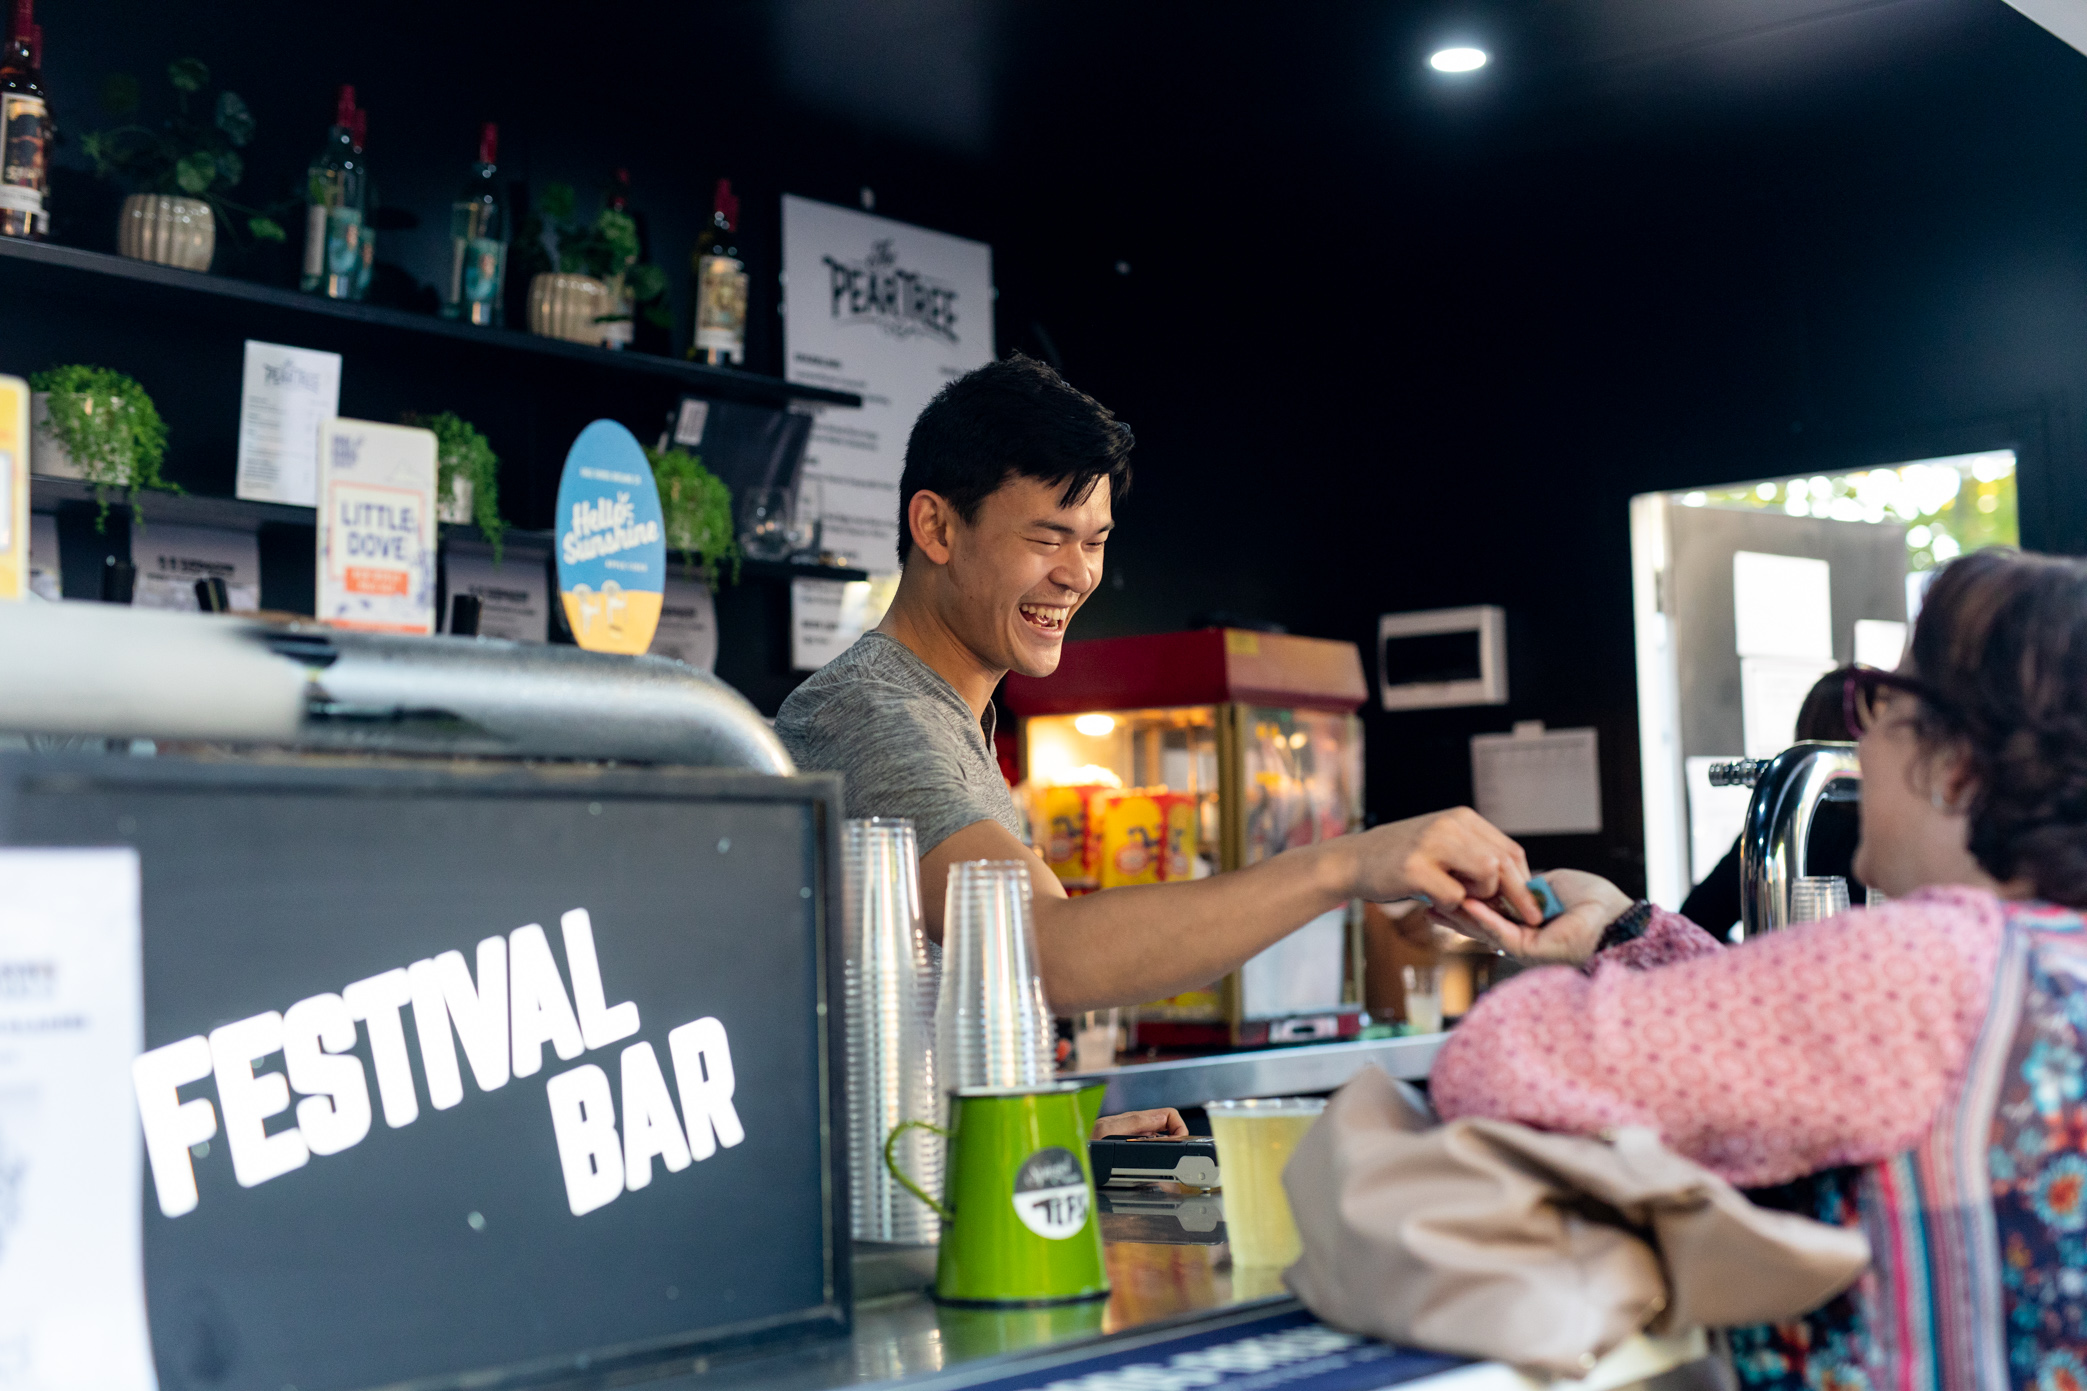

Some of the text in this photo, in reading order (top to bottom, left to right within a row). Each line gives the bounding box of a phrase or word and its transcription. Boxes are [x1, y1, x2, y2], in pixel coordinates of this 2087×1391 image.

[341, 500, 414, 534] LITTLE
[571, 496, 632, 538] Hello
[347, 531, 406, 562] DOVE
[562, 520, 660, 565] Sunshine
[132, 908, 641, 1218] FESTIVAL
[547, 1016, 745, 1216] BAR
